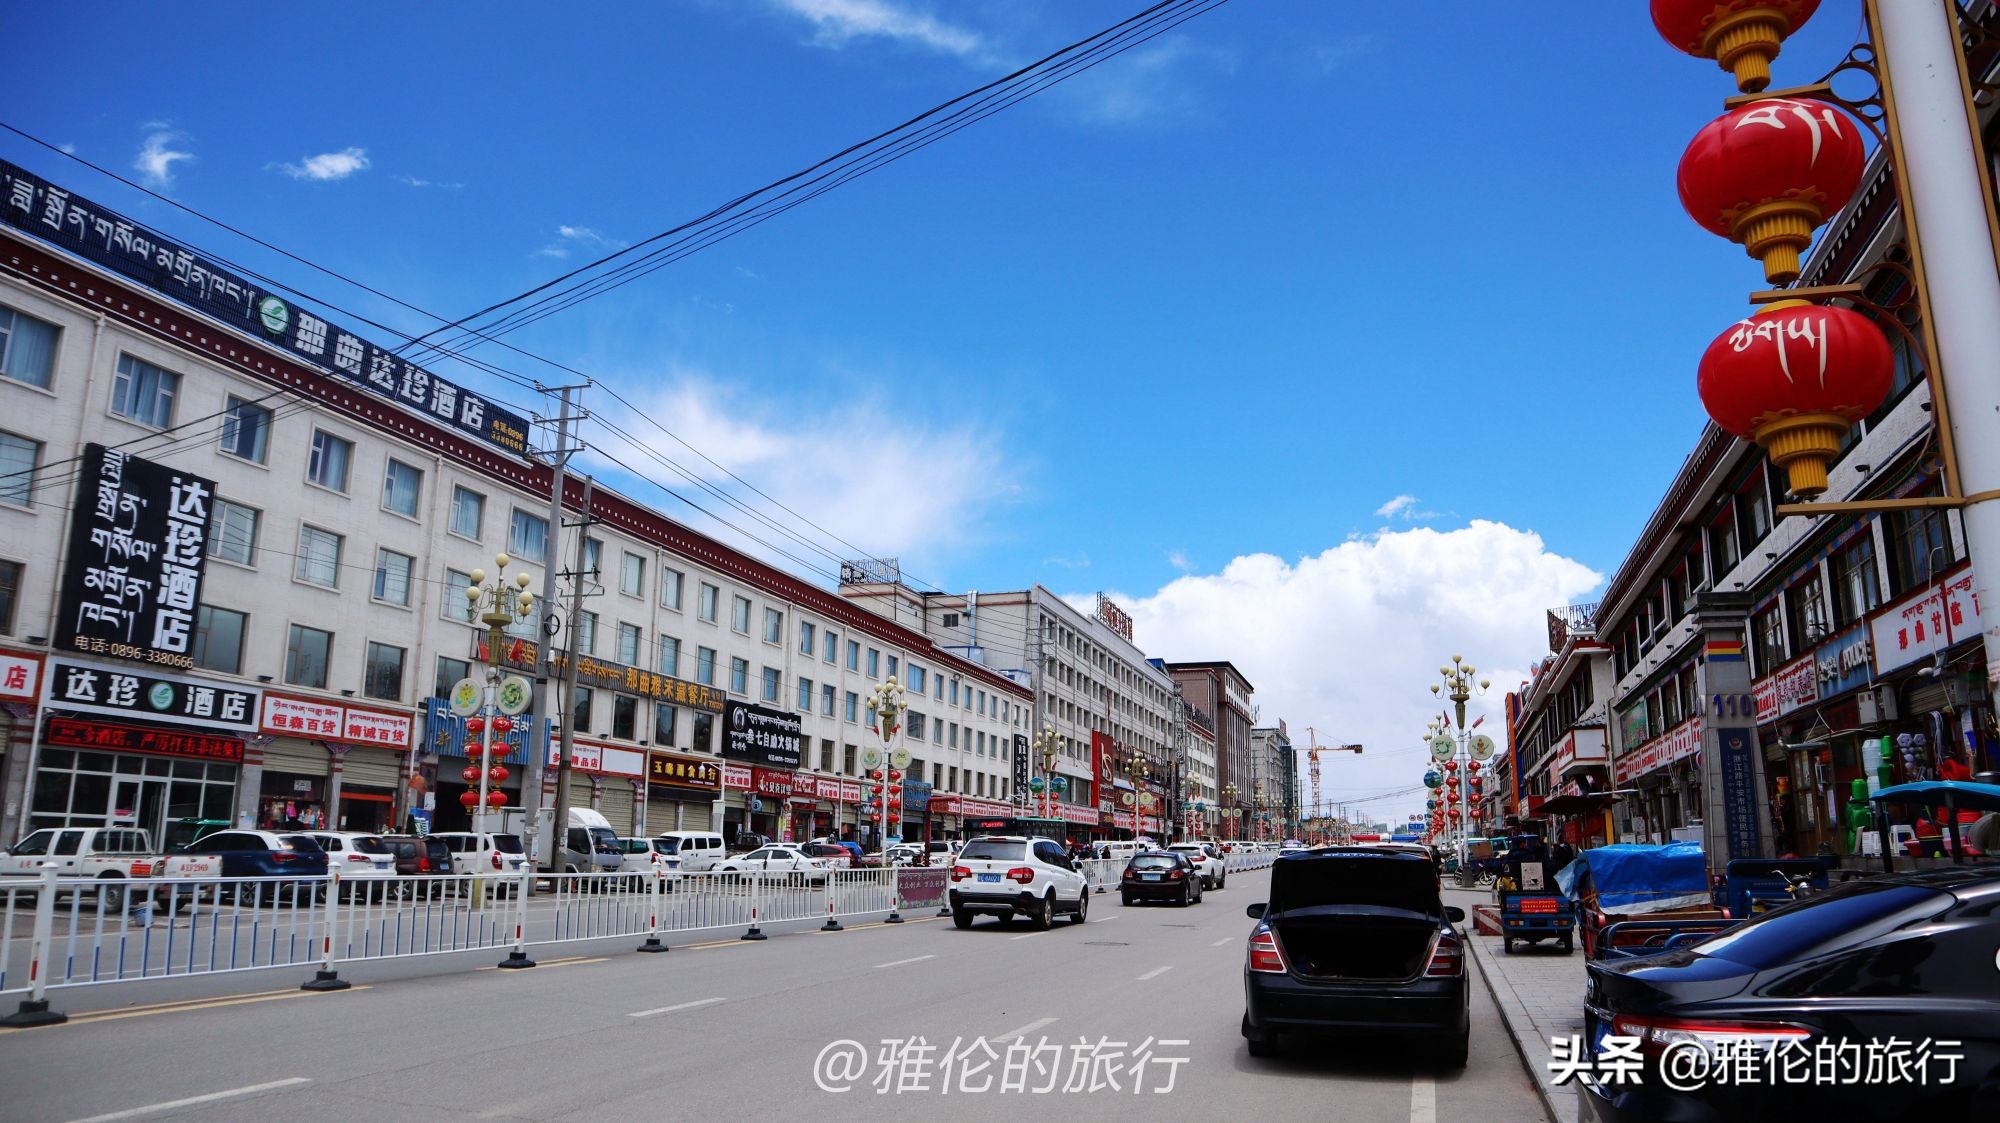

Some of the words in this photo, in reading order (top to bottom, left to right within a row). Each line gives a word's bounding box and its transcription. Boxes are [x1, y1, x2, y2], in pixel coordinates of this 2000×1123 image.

[295, 312, 485, 430] 那曲达珍酒店
[151, 477, 209, 653] 达珍酒店
[4, 665, 28, 690] 店
[64, 668, 140, 707] 达珍
[184, 685, 247, 721] 酒店
[1713, 694, 1753, 717] 110
[348, 723, 405, 742] 精诚百货
[553, 752, 598, 768] 多精品店
